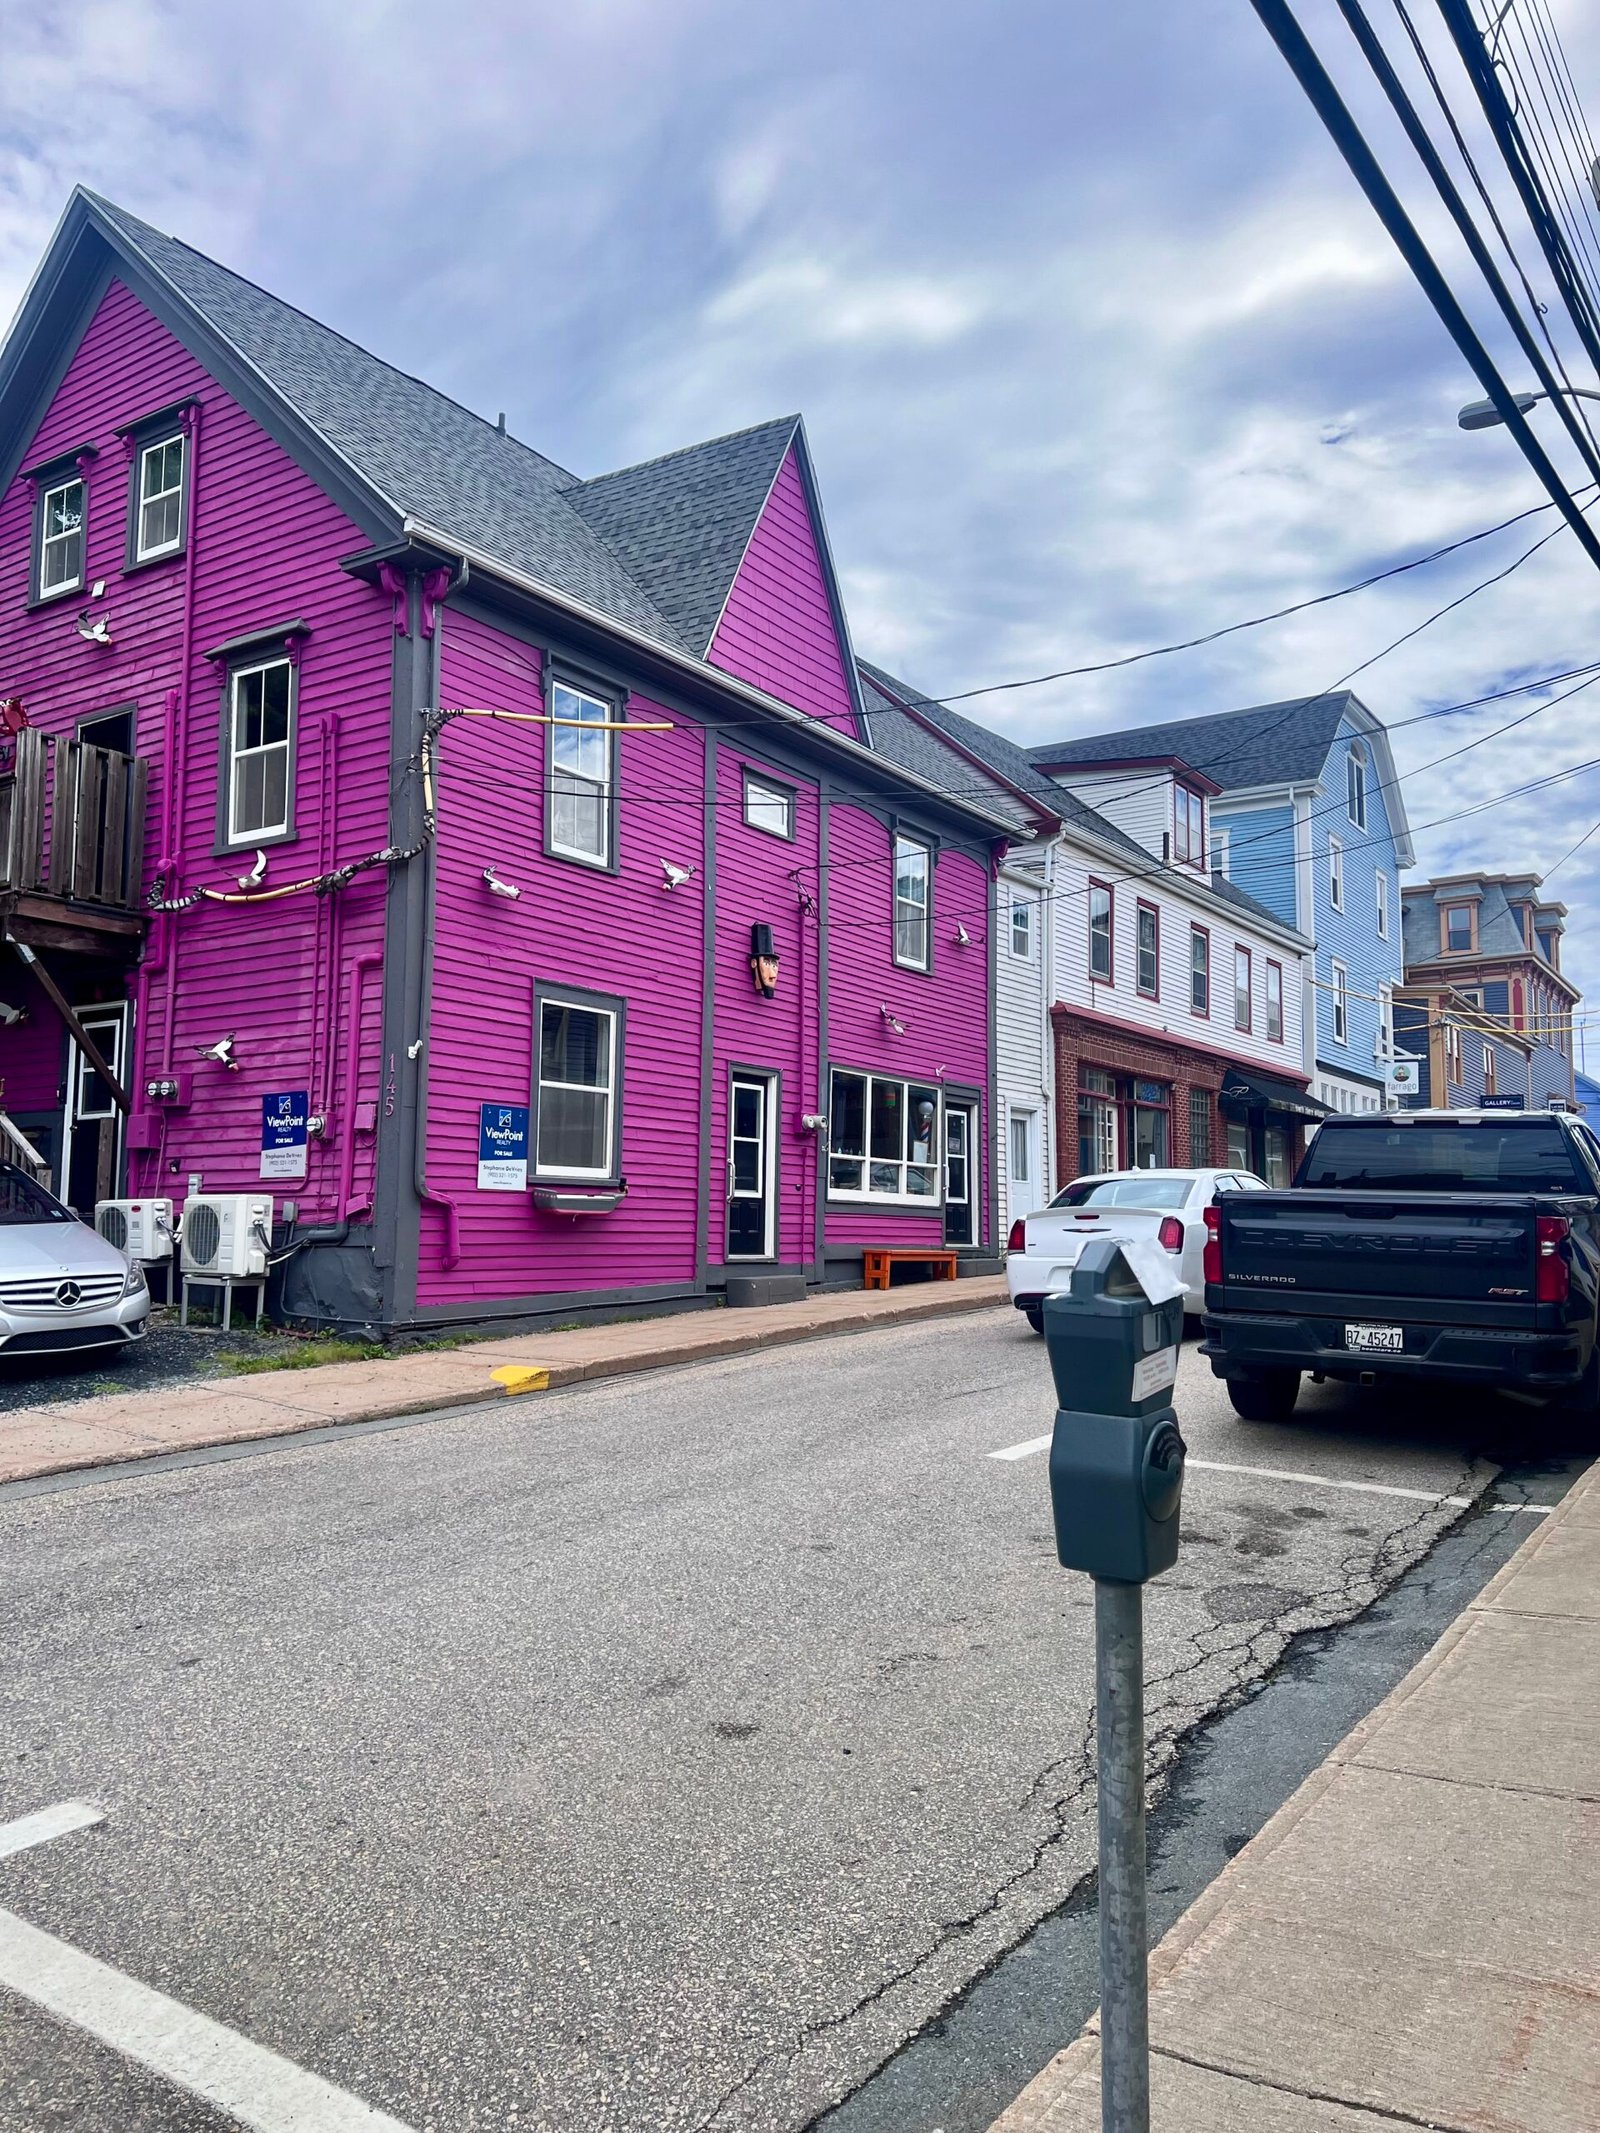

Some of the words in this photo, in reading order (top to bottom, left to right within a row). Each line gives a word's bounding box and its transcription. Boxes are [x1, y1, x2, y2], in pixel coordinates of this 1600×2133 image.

[385, 1053, 396, 1116] 145
[1387, 1081, 1417, 1092] farrago
[266, 1115, 304, 1127] ViewPoint
[485, 1126, 524, 1141] ViewPoint
[1241, 1230, 1511, 1255] CHEVROLET
[1228, 1273, 1296, 1284] SILVERADO
[1487, 1287, 1529, 1296] RST
[1346, 1330, 1360, 1344] BZ
[1367, 1331, 1402, 1348] 45247
